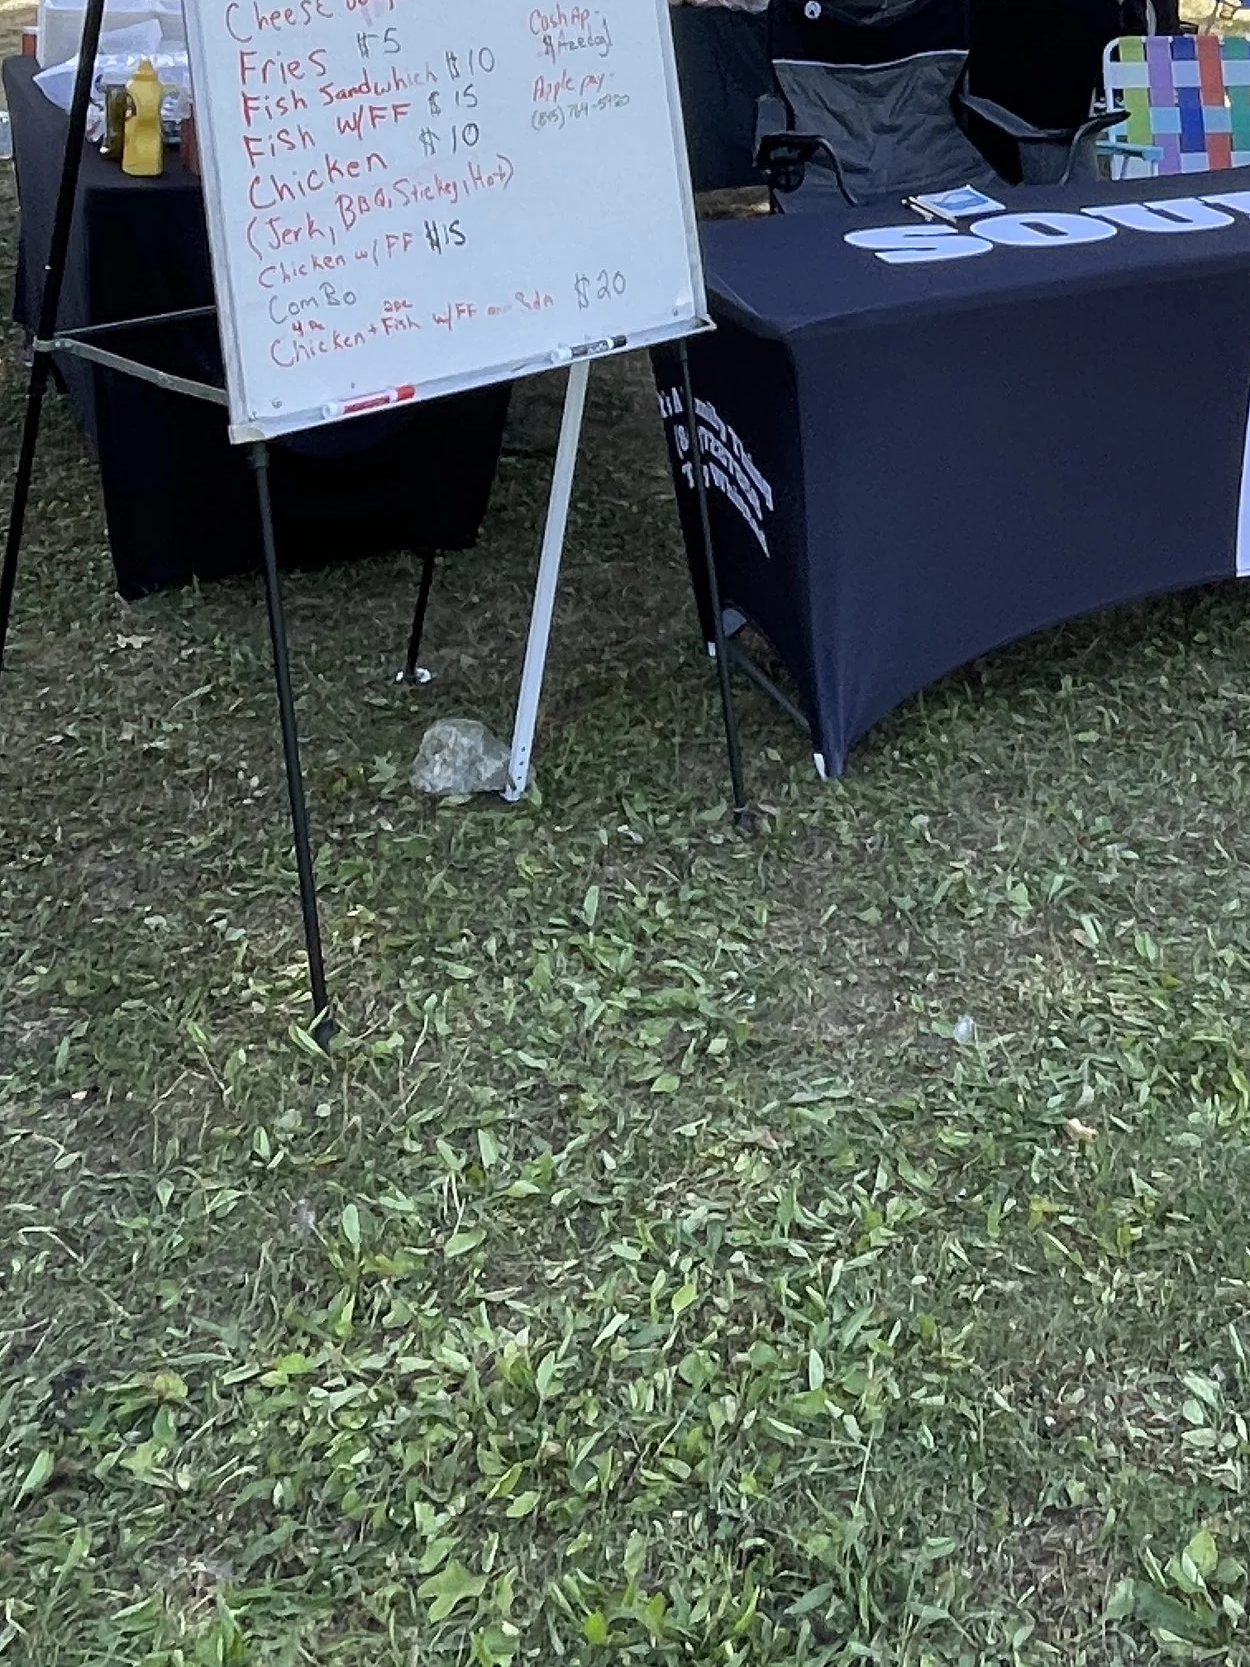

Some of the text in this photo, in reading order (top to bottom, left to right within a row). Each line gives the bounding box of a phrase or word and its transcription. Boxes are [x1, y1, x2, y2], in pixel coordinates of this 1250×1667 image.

[240, 89, 308, 127] Fish
[319, 61, 438, 107] Sandwhich
[532, 68, 576, 103] Apple
[243, 124, 316, 169] Fish
[249, 152, 388, 210] Chicken
[257, 253, 346, 288] Chicken
[270, 328, 366, 368] Chicken
[380, 313, 421, 336] Fish
